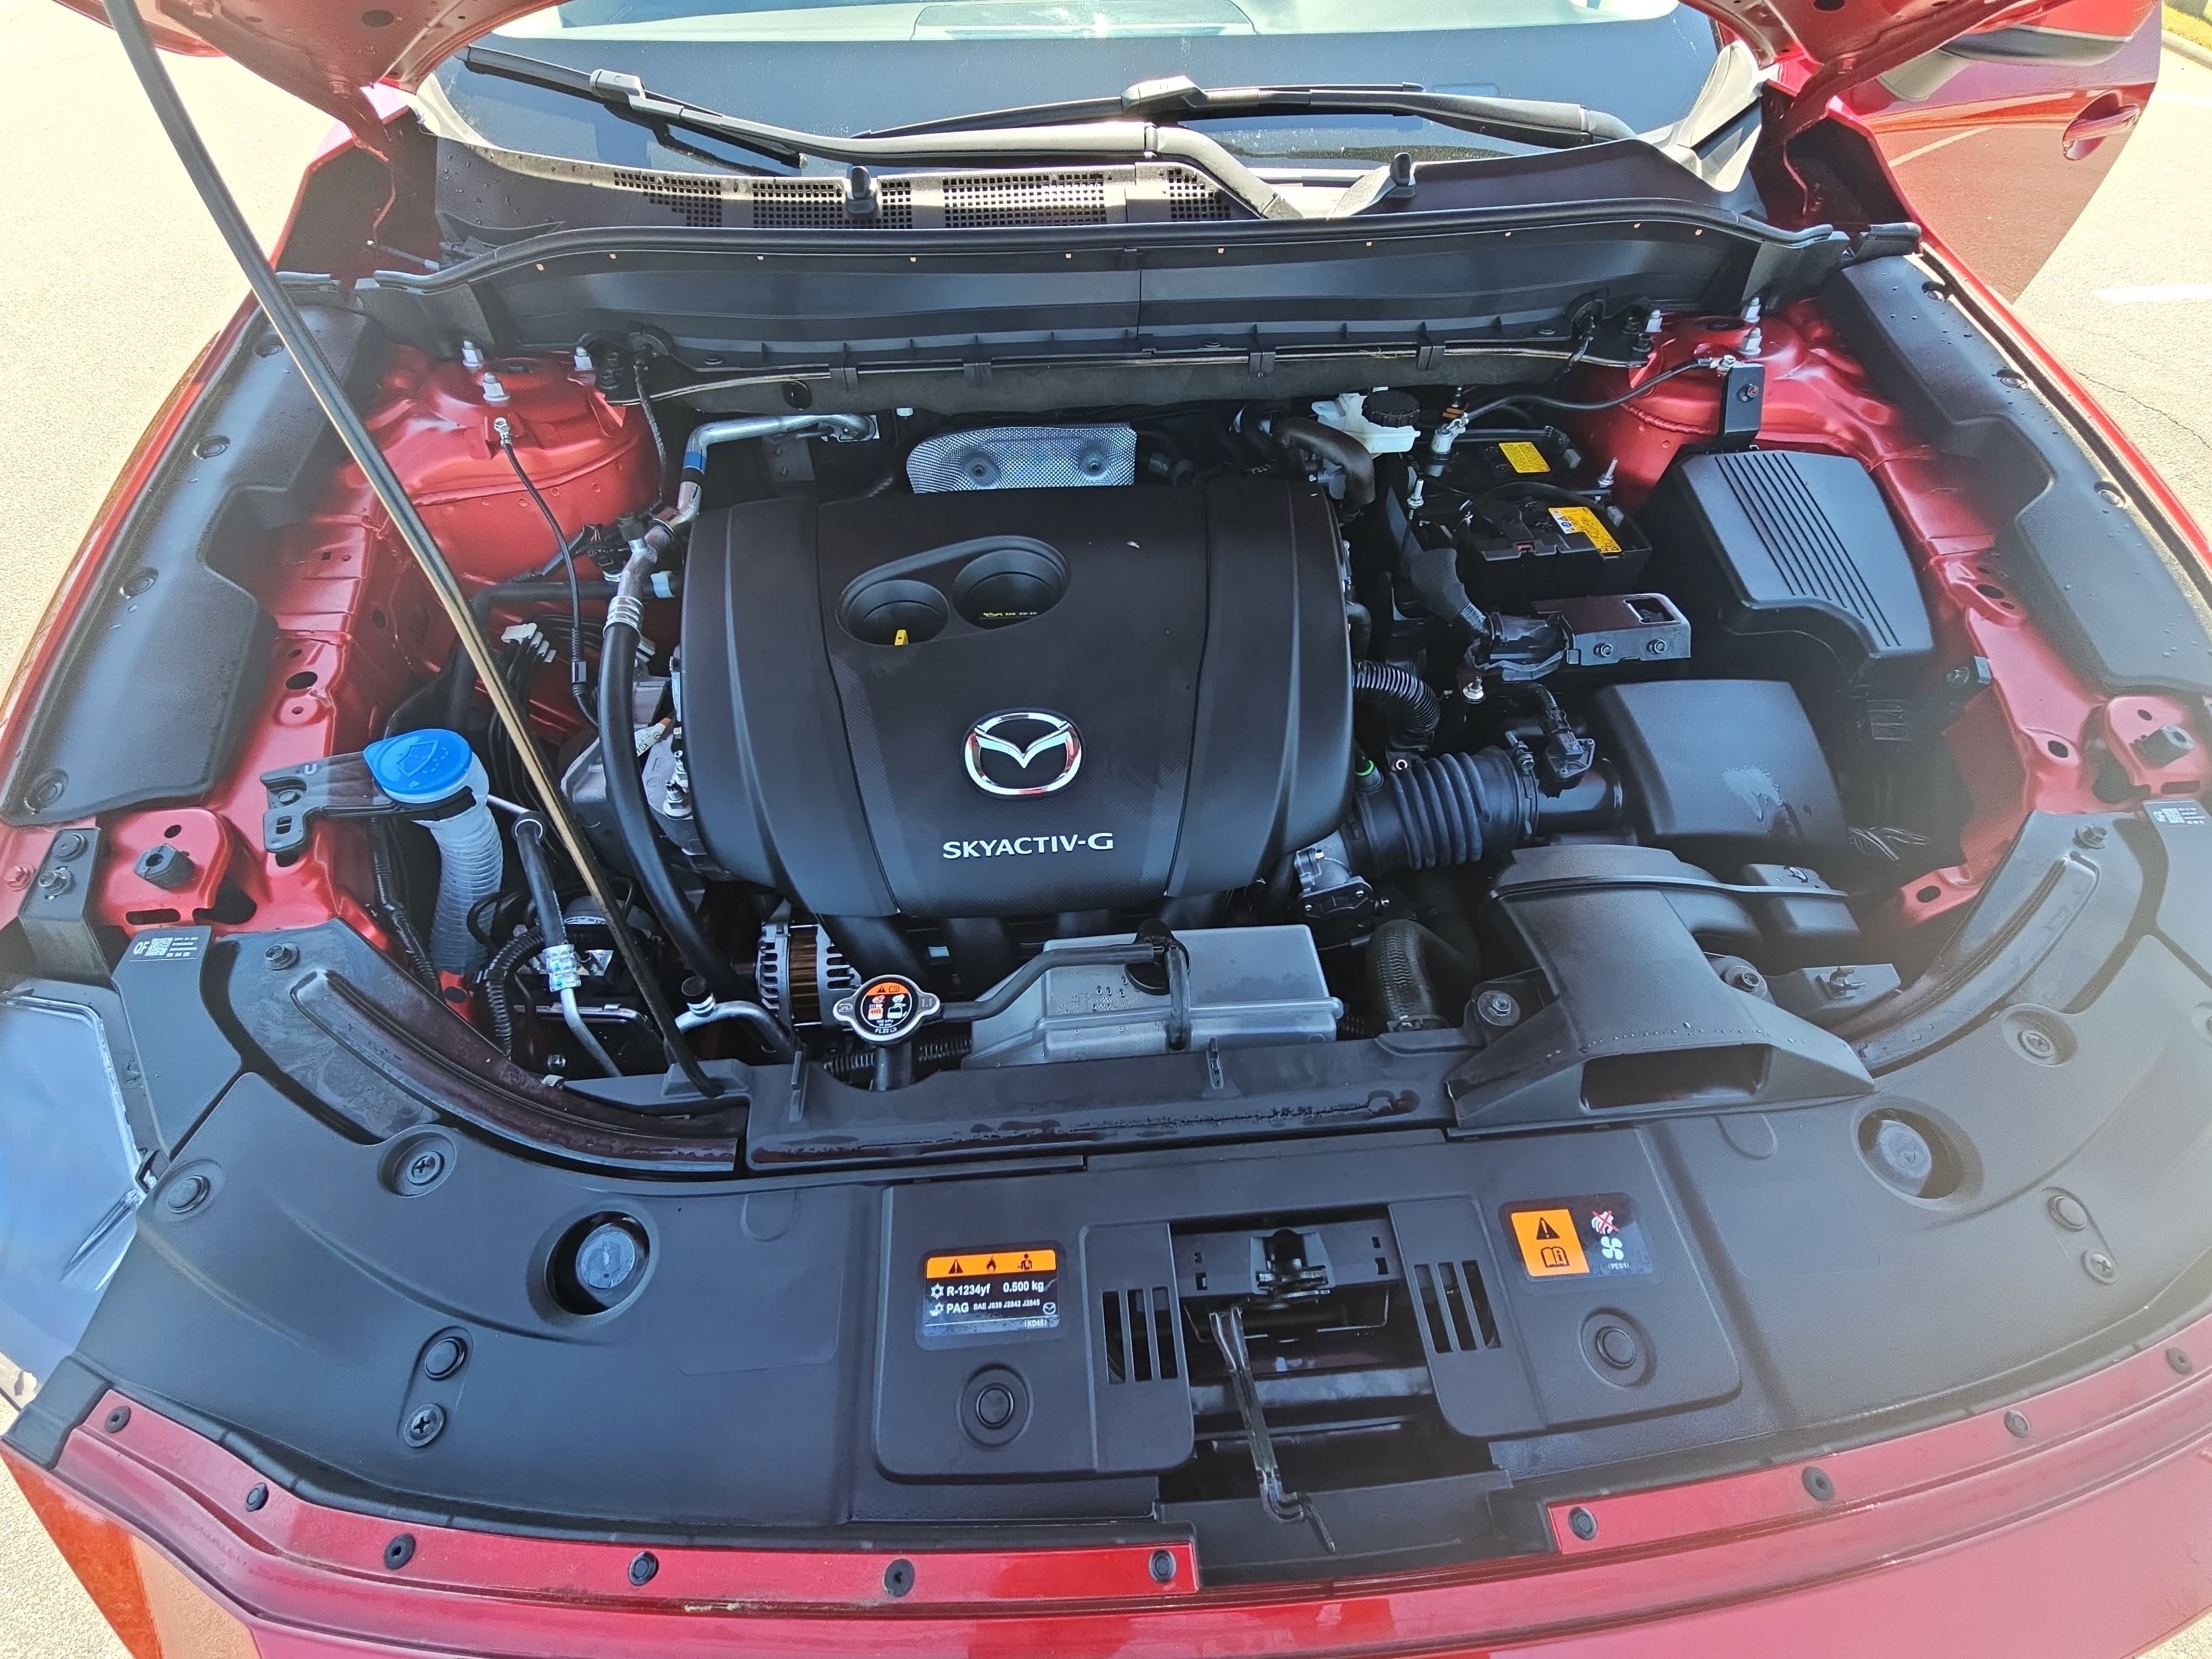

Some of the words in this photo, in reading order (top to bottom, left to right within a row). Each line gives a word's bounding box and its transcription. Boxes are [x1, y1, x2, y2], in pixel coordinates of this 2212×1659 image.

[942, 832, 1114, 859] SKYACTIV-G
[946, 1283, 991, 1296] R-1234yf
[1003, 1281, 1030, 1293] 0.500
[1031, 1280, 1044, 1292] kg
[946, 1303, 969, 1314] PAG
